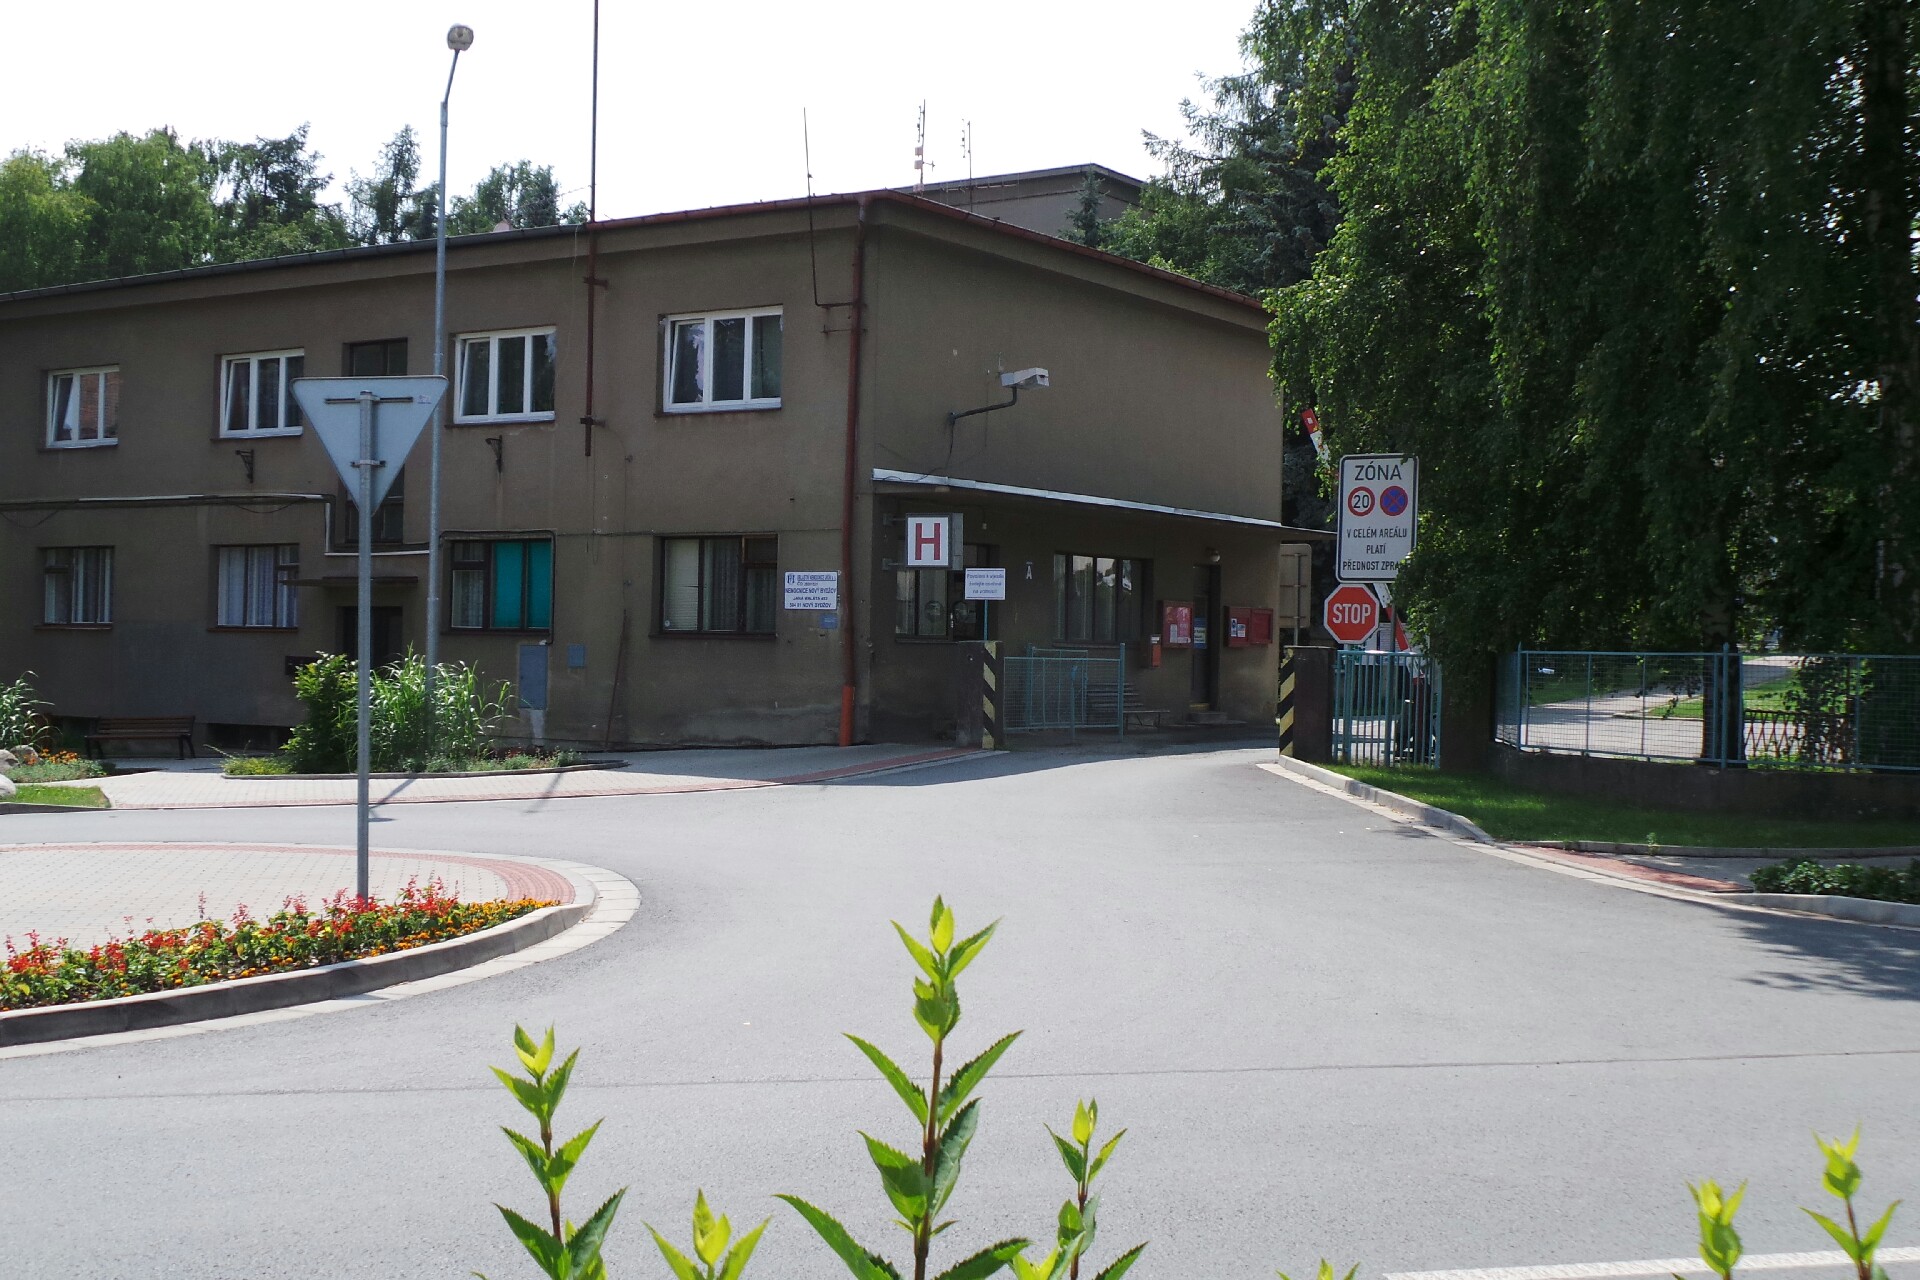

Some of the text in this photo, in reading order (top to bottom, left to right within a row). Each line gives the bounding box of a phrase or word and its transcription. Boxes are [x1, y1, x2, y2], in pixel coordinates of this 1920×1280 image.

[1354, 461, 1402, 481] ZÓNA
[1353, 494, 1370, 509] 20
[1346, 526, 1408, 539] V CELÉM AREÁLU
[915, 523, 941, 560] H
[1366, 542, 1386, 555] PLATÍ
[1342, 558, 1379, 571] PŘEDNOST
[1332, 603, 1372, 625] STOP
